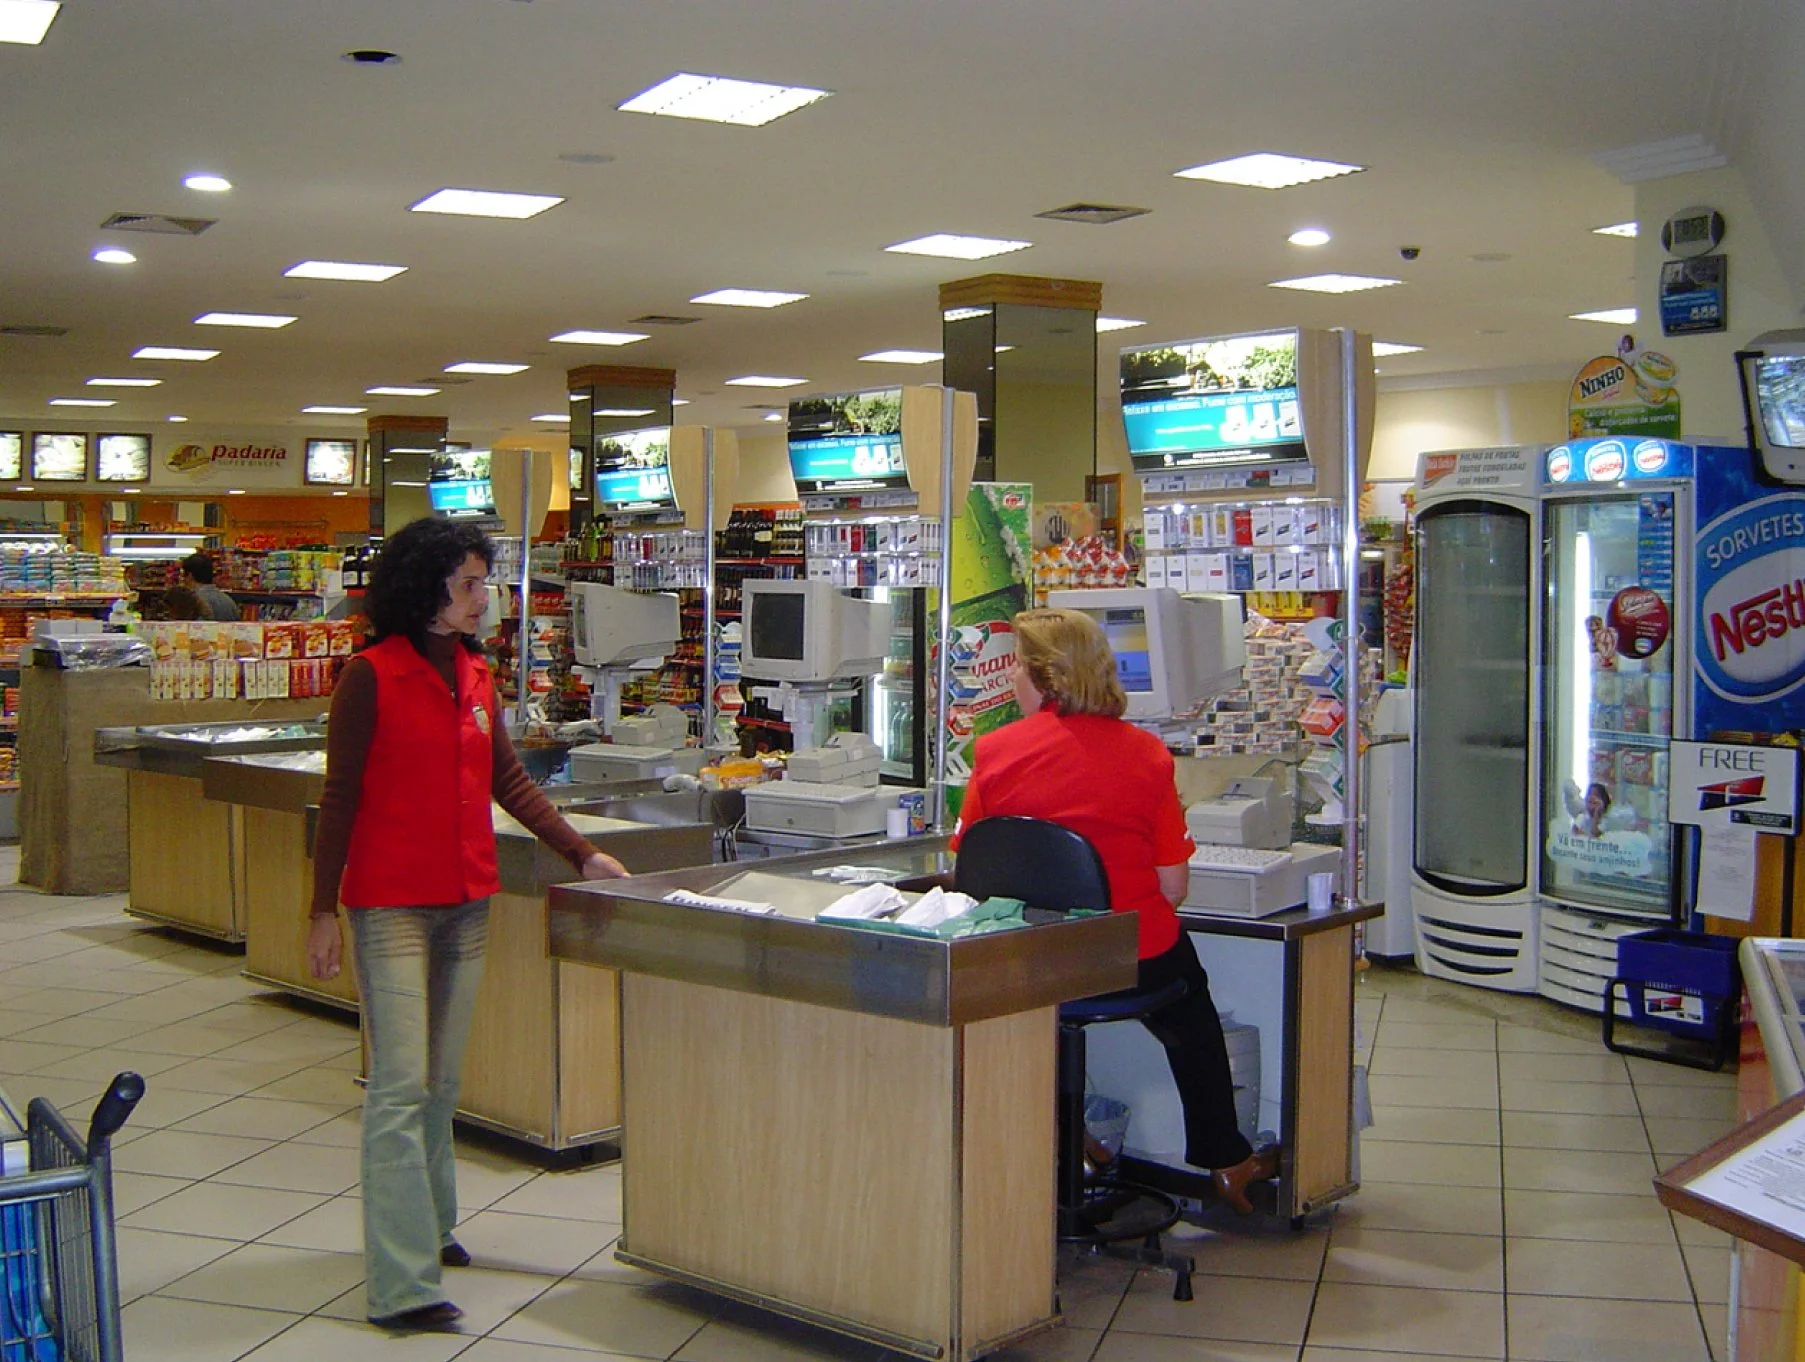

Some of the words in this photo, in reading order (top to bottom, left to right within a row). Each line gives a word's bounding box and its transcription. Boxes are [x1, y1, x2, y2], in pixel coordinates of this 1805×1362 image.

[1579, 366, 1625, 399] NINHO
[1706, 513, 1804, 569] SORVETES
[1710, 577, 1805, 661] Nestl
[1699, 747, 1765, 772] FREE
